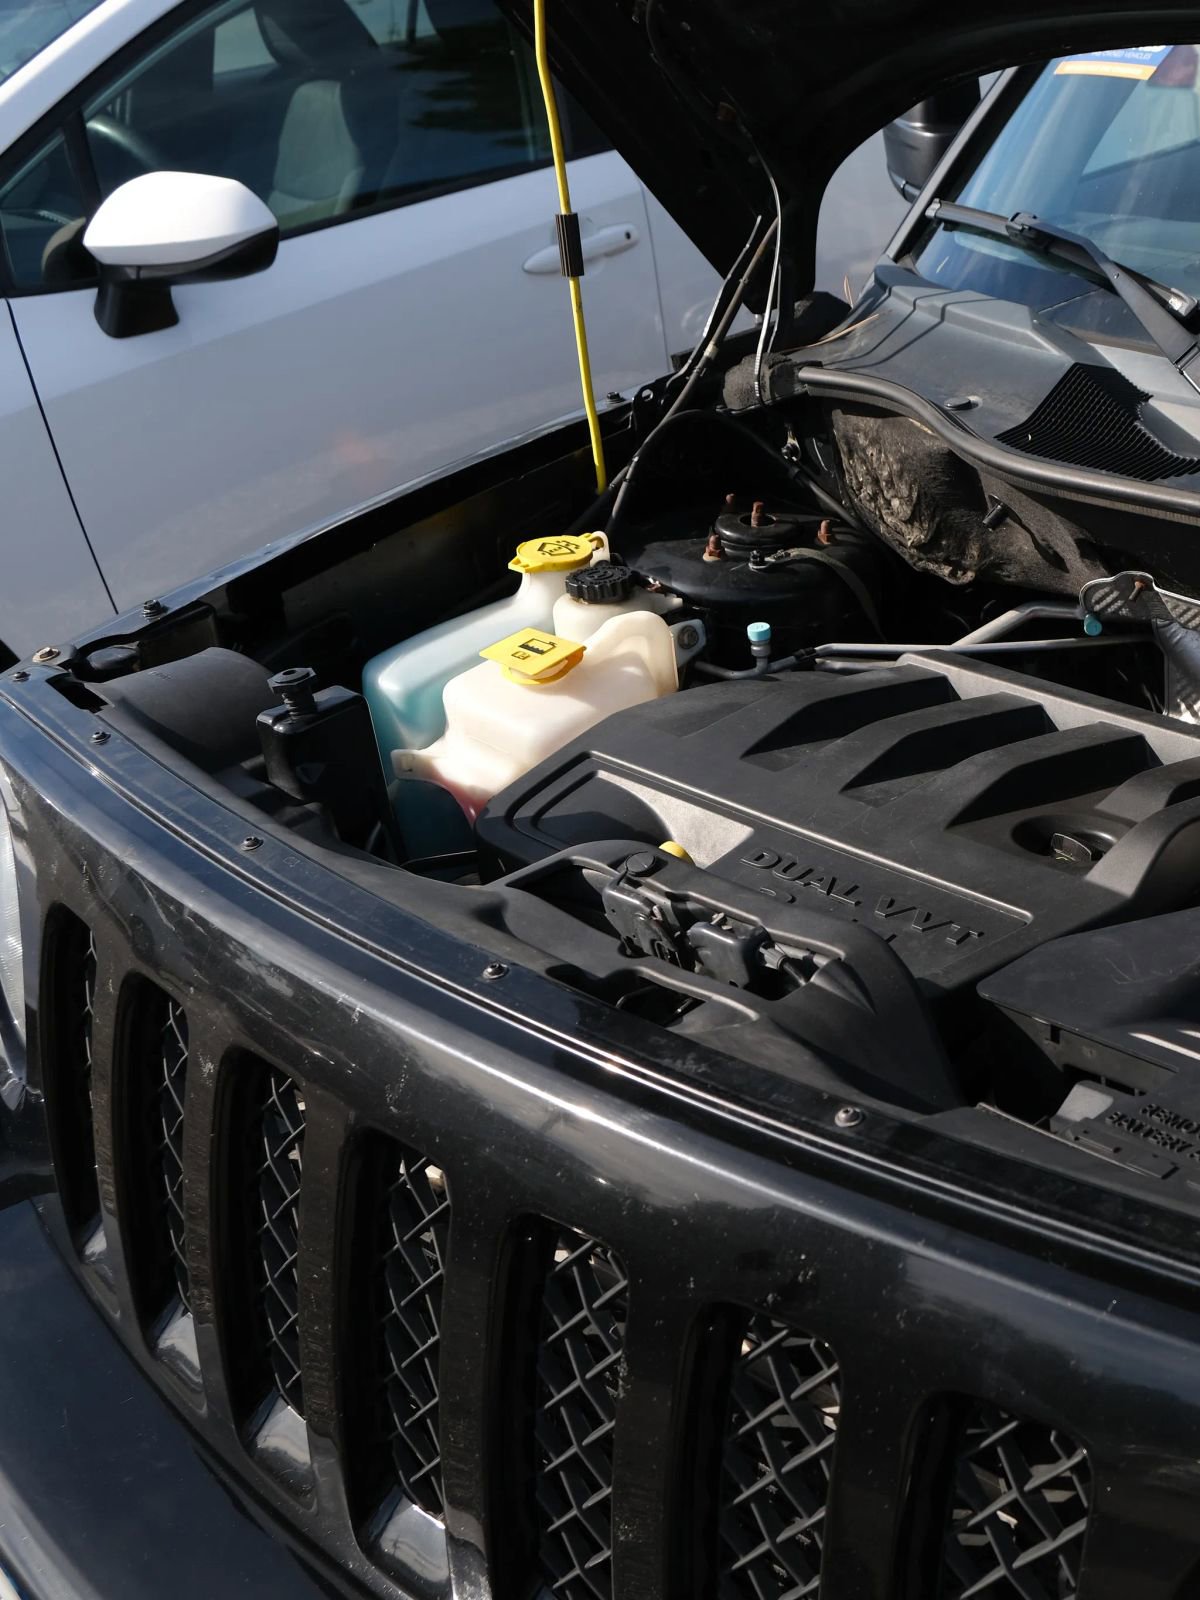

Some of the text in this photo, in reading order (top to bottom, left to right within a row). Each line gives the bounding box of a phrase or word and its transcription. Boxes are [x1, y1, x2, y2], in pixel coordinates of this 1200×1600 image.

[740, 848, 861, 906] DUAL
[875, 896, 984, 946] VVT
[1105, 1111, 1193, 1153] BATTERY
